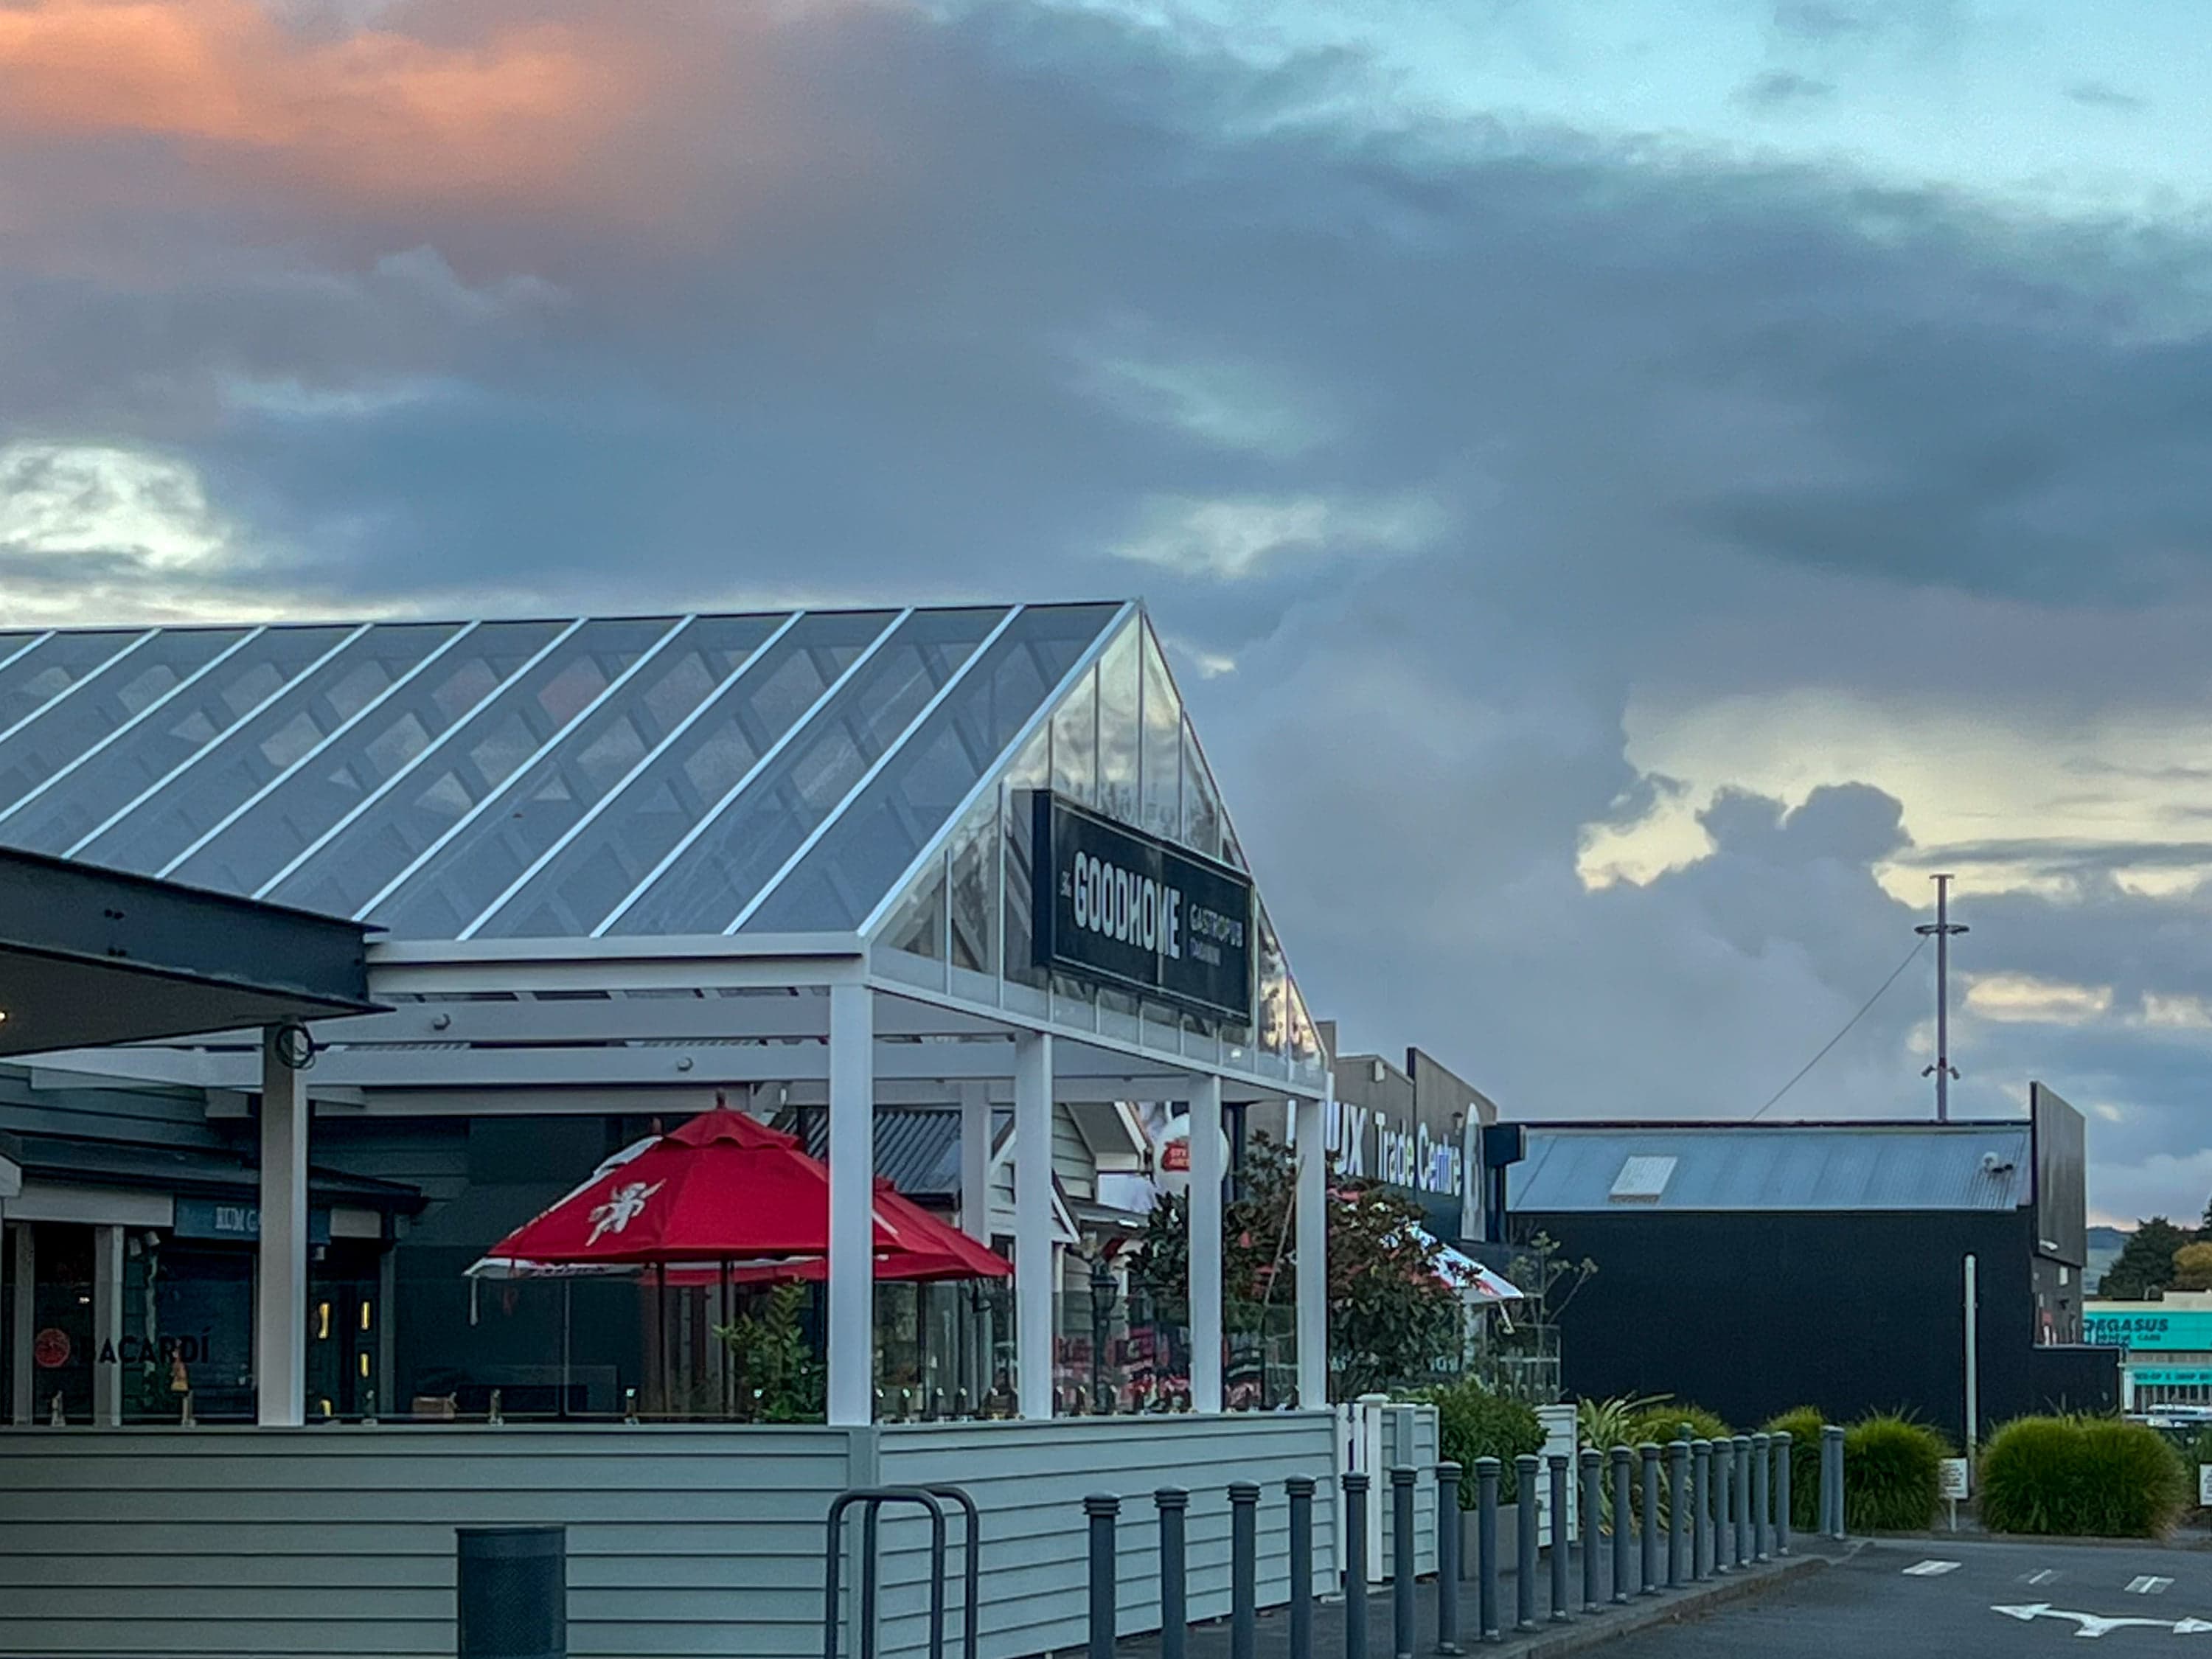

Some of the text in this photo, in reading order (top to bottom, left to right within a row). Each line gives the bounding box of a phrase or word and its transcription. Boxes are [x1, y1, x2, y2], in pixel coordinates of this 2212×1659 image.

[1074, 850, 1180, 960] GOODHOME
[1374, 1111, 1415, 1188] Trade
[1416, 1121, 1461, 1197] Centre
[2082, 1318, 2169, 1332] PEGASUS
